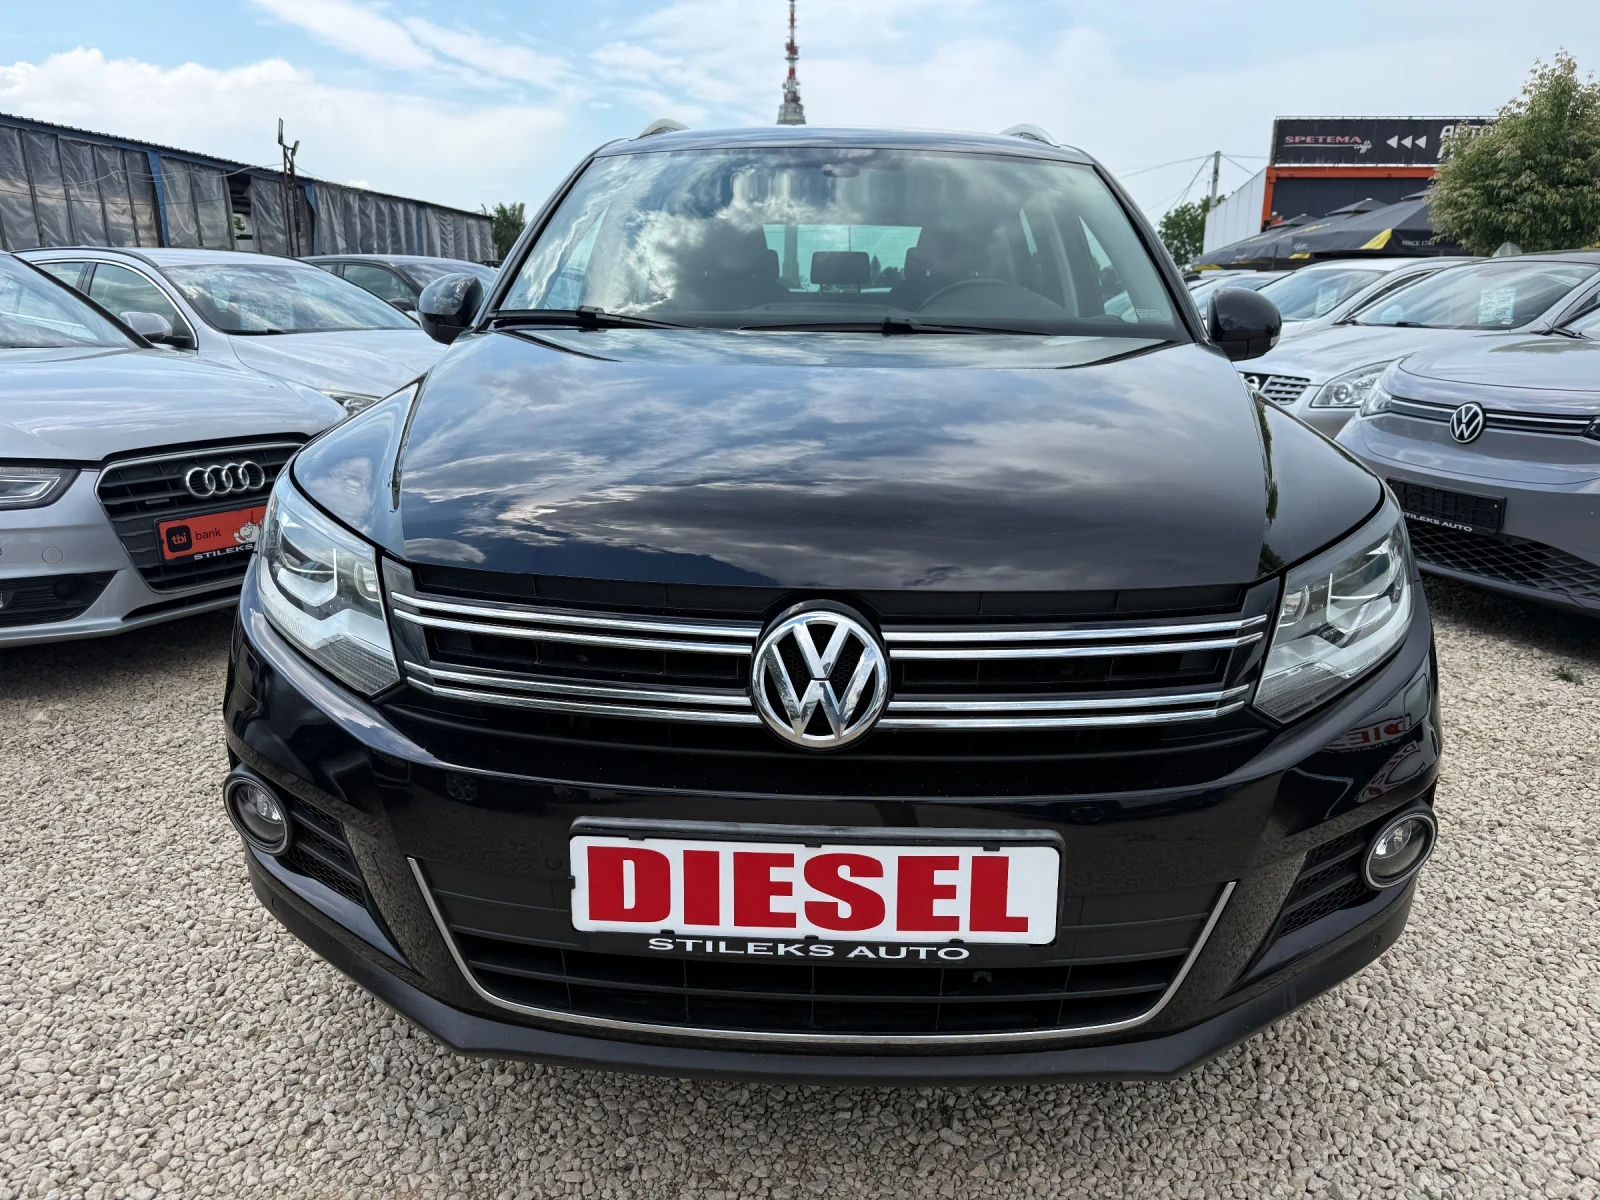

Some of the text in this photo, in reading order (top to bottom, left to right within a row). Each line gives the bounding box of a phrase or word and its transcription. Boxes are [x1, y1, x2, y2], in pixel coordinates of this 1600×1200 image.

[1442, 521, 1473, 532] AUTO
[171, 528, 222, 545] tbi bank
[194, 543, 254, 560] STILEKS
[587, 846, 1029, 932] DIESEL
[648, 938, 970, 960] STILEKS AUTO
